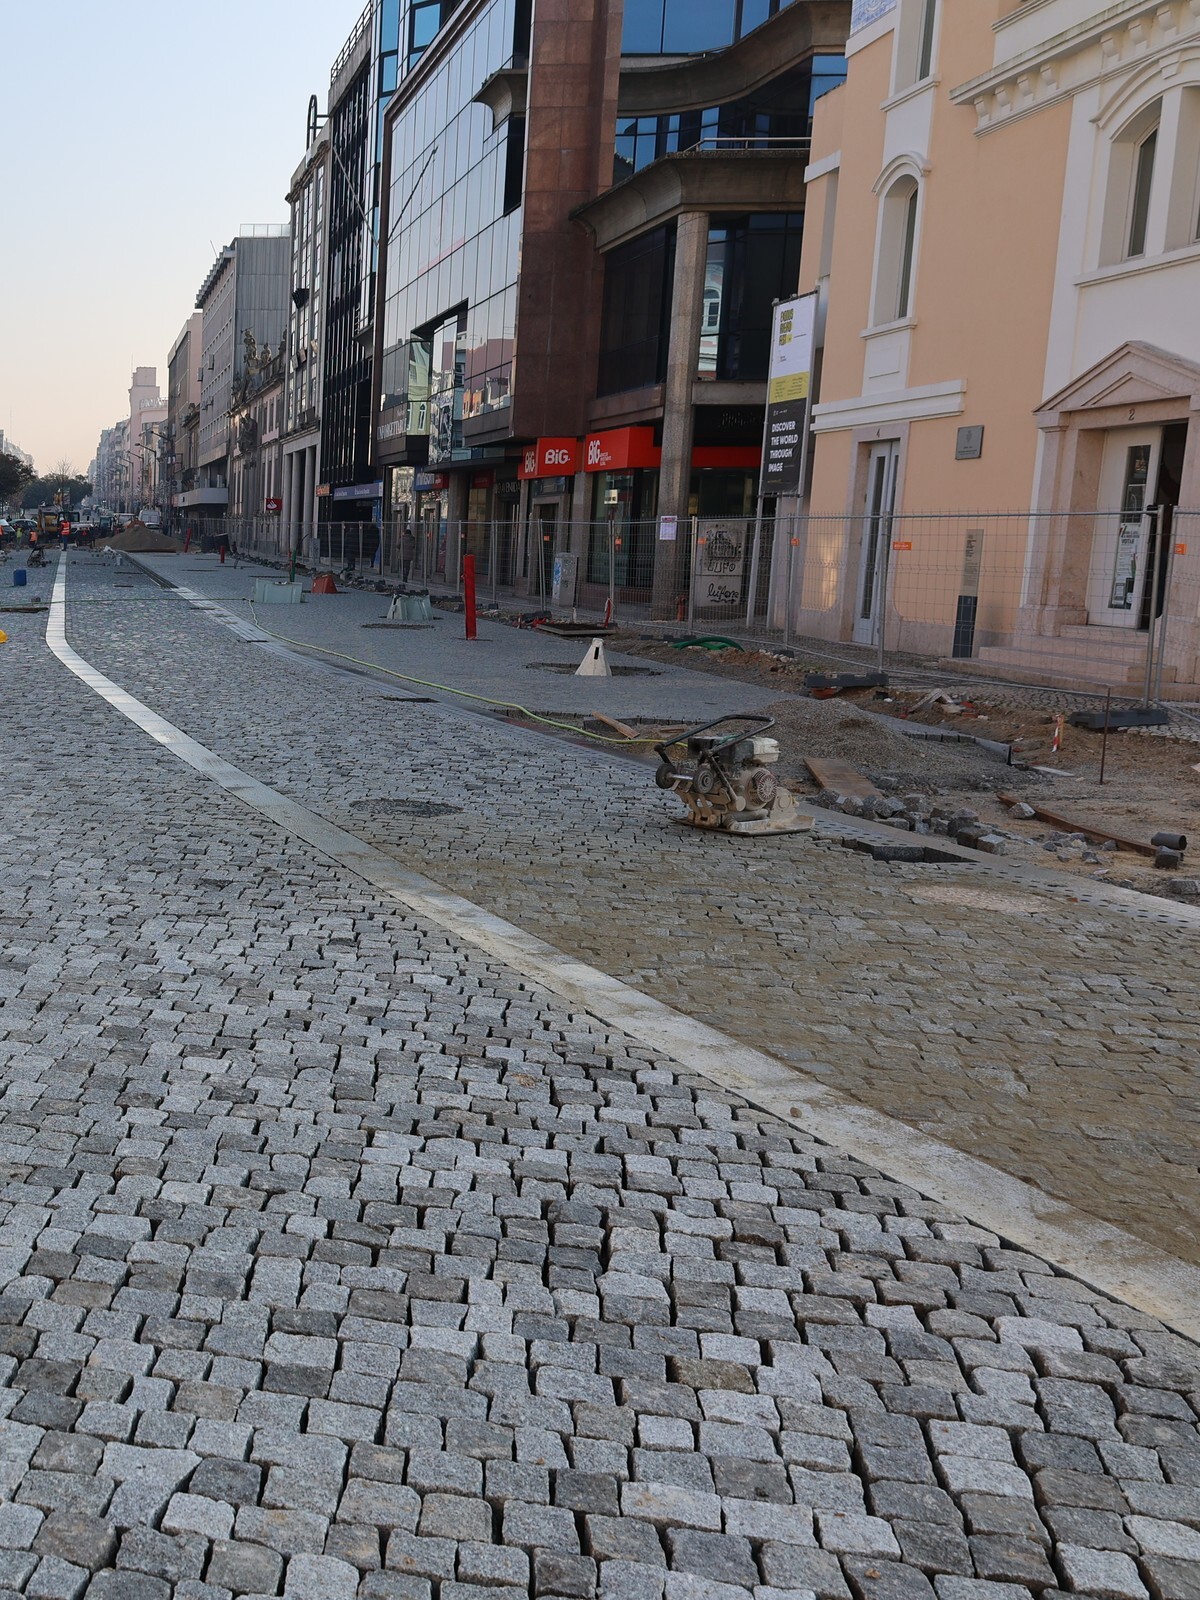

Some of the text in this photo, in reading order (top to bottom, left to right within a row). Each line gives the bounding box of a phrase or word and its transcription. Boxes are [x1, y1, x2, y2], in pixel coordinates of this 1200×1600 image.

[1128, 407, 1135, 421] 2
[772, 421, 795, 433] DISCOVER
[876, 428, 881, 438] 4
[771, 435, 798, 446] THE WORLD
[770, 449, 792, 460] THROUGH
[769, 463, 783, 473] IMAGE
